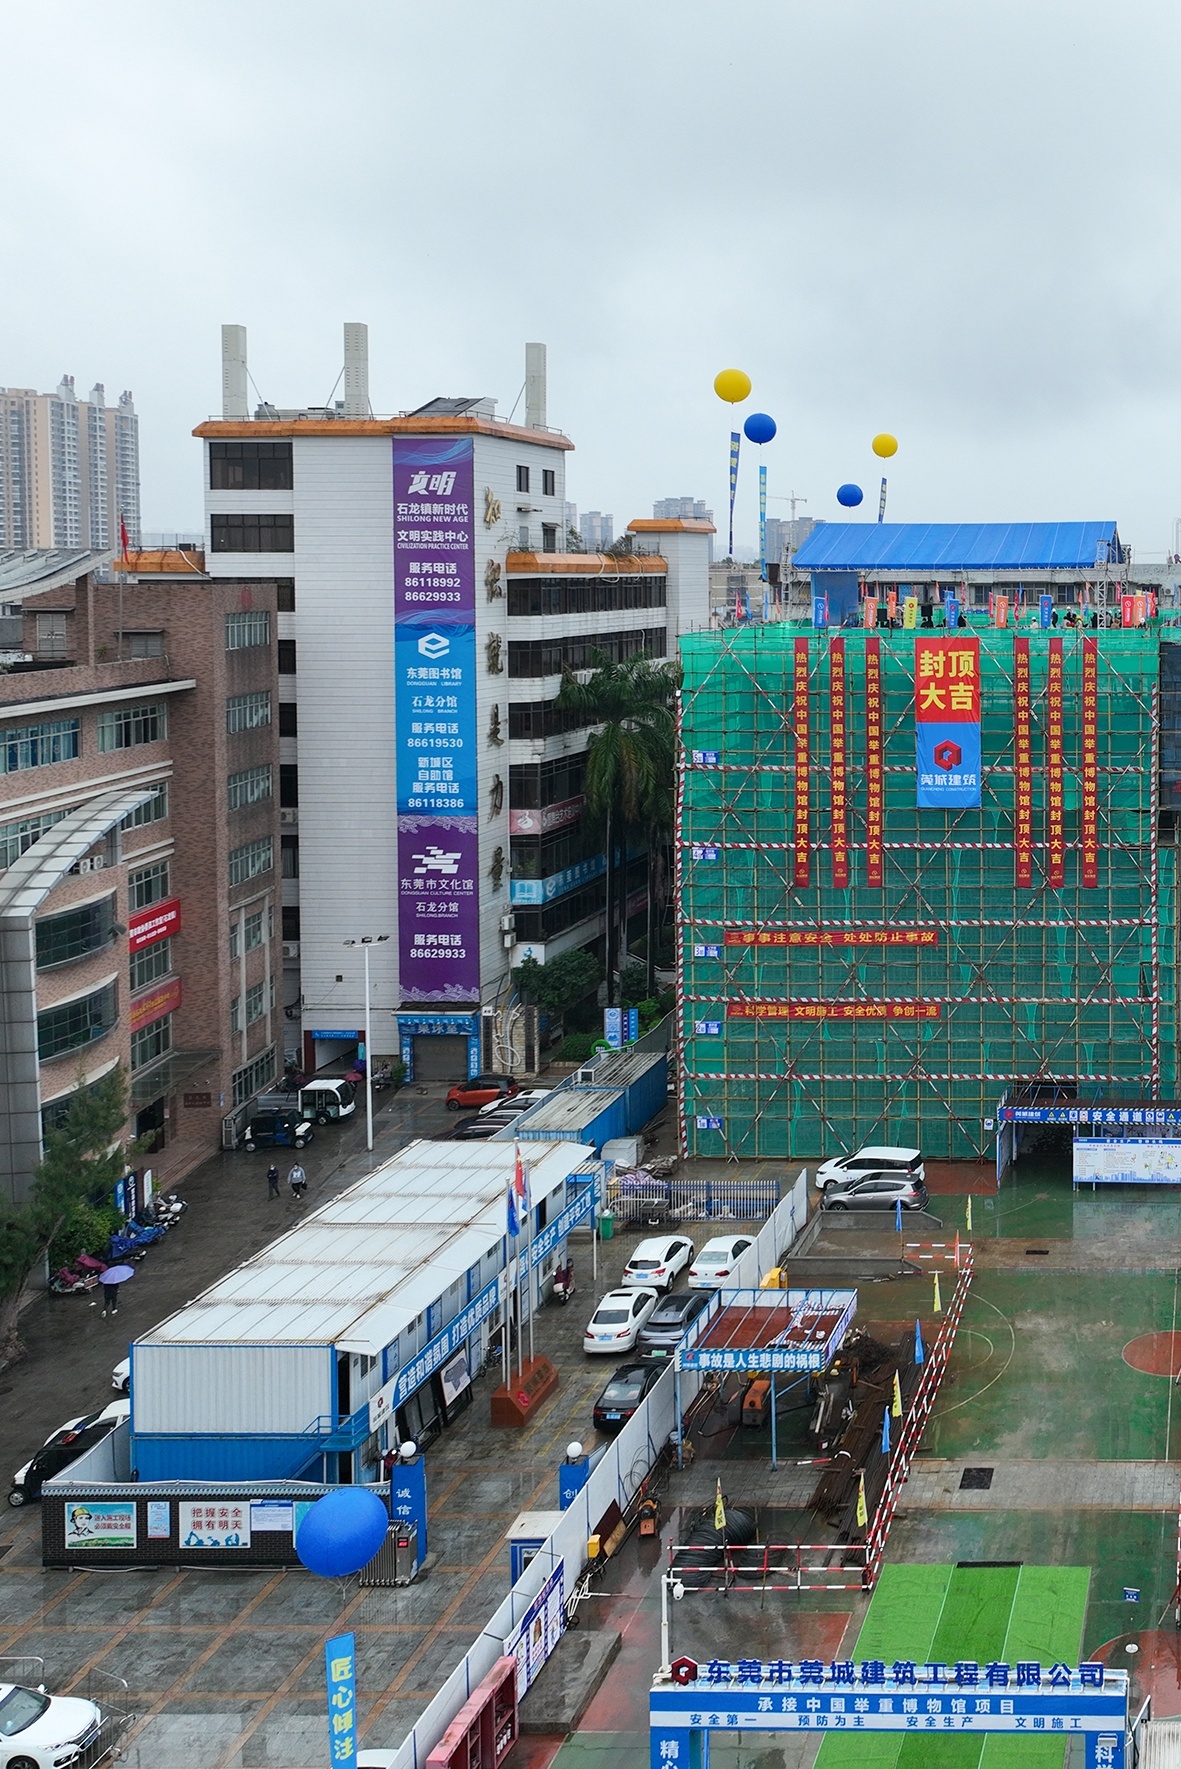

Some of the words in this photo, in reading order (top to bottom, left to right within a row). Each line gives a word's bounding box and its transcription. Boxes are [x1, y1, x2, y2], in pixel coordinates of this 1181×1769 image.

[397, 503, 469, 515] 石龙镇新时代
[397, 515, 431, 523] SHILONG
[432, 515, 450, 523] NEW
[451, 515, 469, 523] AGE
[397, 530, 469, 543] 文明实践中心
[409, 562, 457, 574] 服务电话
[404, 577, 461, 588] 86118992
[404, 592, 461, 602] 86629933
[920, 650, 975, 679] 封顶
[407, 667, 463, 680] 东莞图书馆
[412, 696, 458, 708] 石龙分馆
[920, 682, 974, 711] 大吉
[411, 722, 459, 734] 服务电话
[407, 738, 463, 748] 86619530
[418, 757, 453, 768] 新城区
[796, 652, 808, 863] 热烈庆祝中国举重博物馆封顶大吉
[831, 652, 845, 862] 热烈庆祝中国举重博物馆封顶大吉
[867, 653, 880, 864] 热烈庆祝中国举重博物馆封顶大吉
[1017, 652, 1029, 863] 热烈庆祝中国举重博物馆封顶大吉
[1050, 652, 1062, 864] 热烈庆祝中国举重博物馆封顶大吉
[1083, 652, 1096, 863] 热烈庆祝中国举重博物馆封顶大吉
[418, 770, 453, 781] 自助馆
[920, 774, 976, 786] 莞城建筑
[412, 782, 460, 794] 服务电话
[408, 799, 464, 808] 86118386
[400, 878, 474, 890] 东莞市文化馆
[416, 902, 459, 912] 石龙分馆
[414, 934, 462, 946] 服务电话
[844, 931, 935, 943] 处处防止事故
[410, 949, 466, 959] 86629933
[893, 1005, 937, 1016] 争创一流
[1092, 1111, 1142, 1121] 安全通道
[699, 1353, 821, 1369] 事故是人生悲剧的祸根
[192, 1508, 242, 1517] 把握安全
[192, 1520, 242, 1530] 拥有明天
[704, 1659, 1106, 1687] 东莞市莞城建筑工程有限公司
[758, 1697, 1016, 1714] 承接中国举重博物馆项目
[690, 1714, 758, 1726] 安全第一
[797, 1714, 865, 1727] 预防为主
[906, 1716, 973, 1728] 安全生产
[1015, 1717, 1082, 1729] 文明施工
